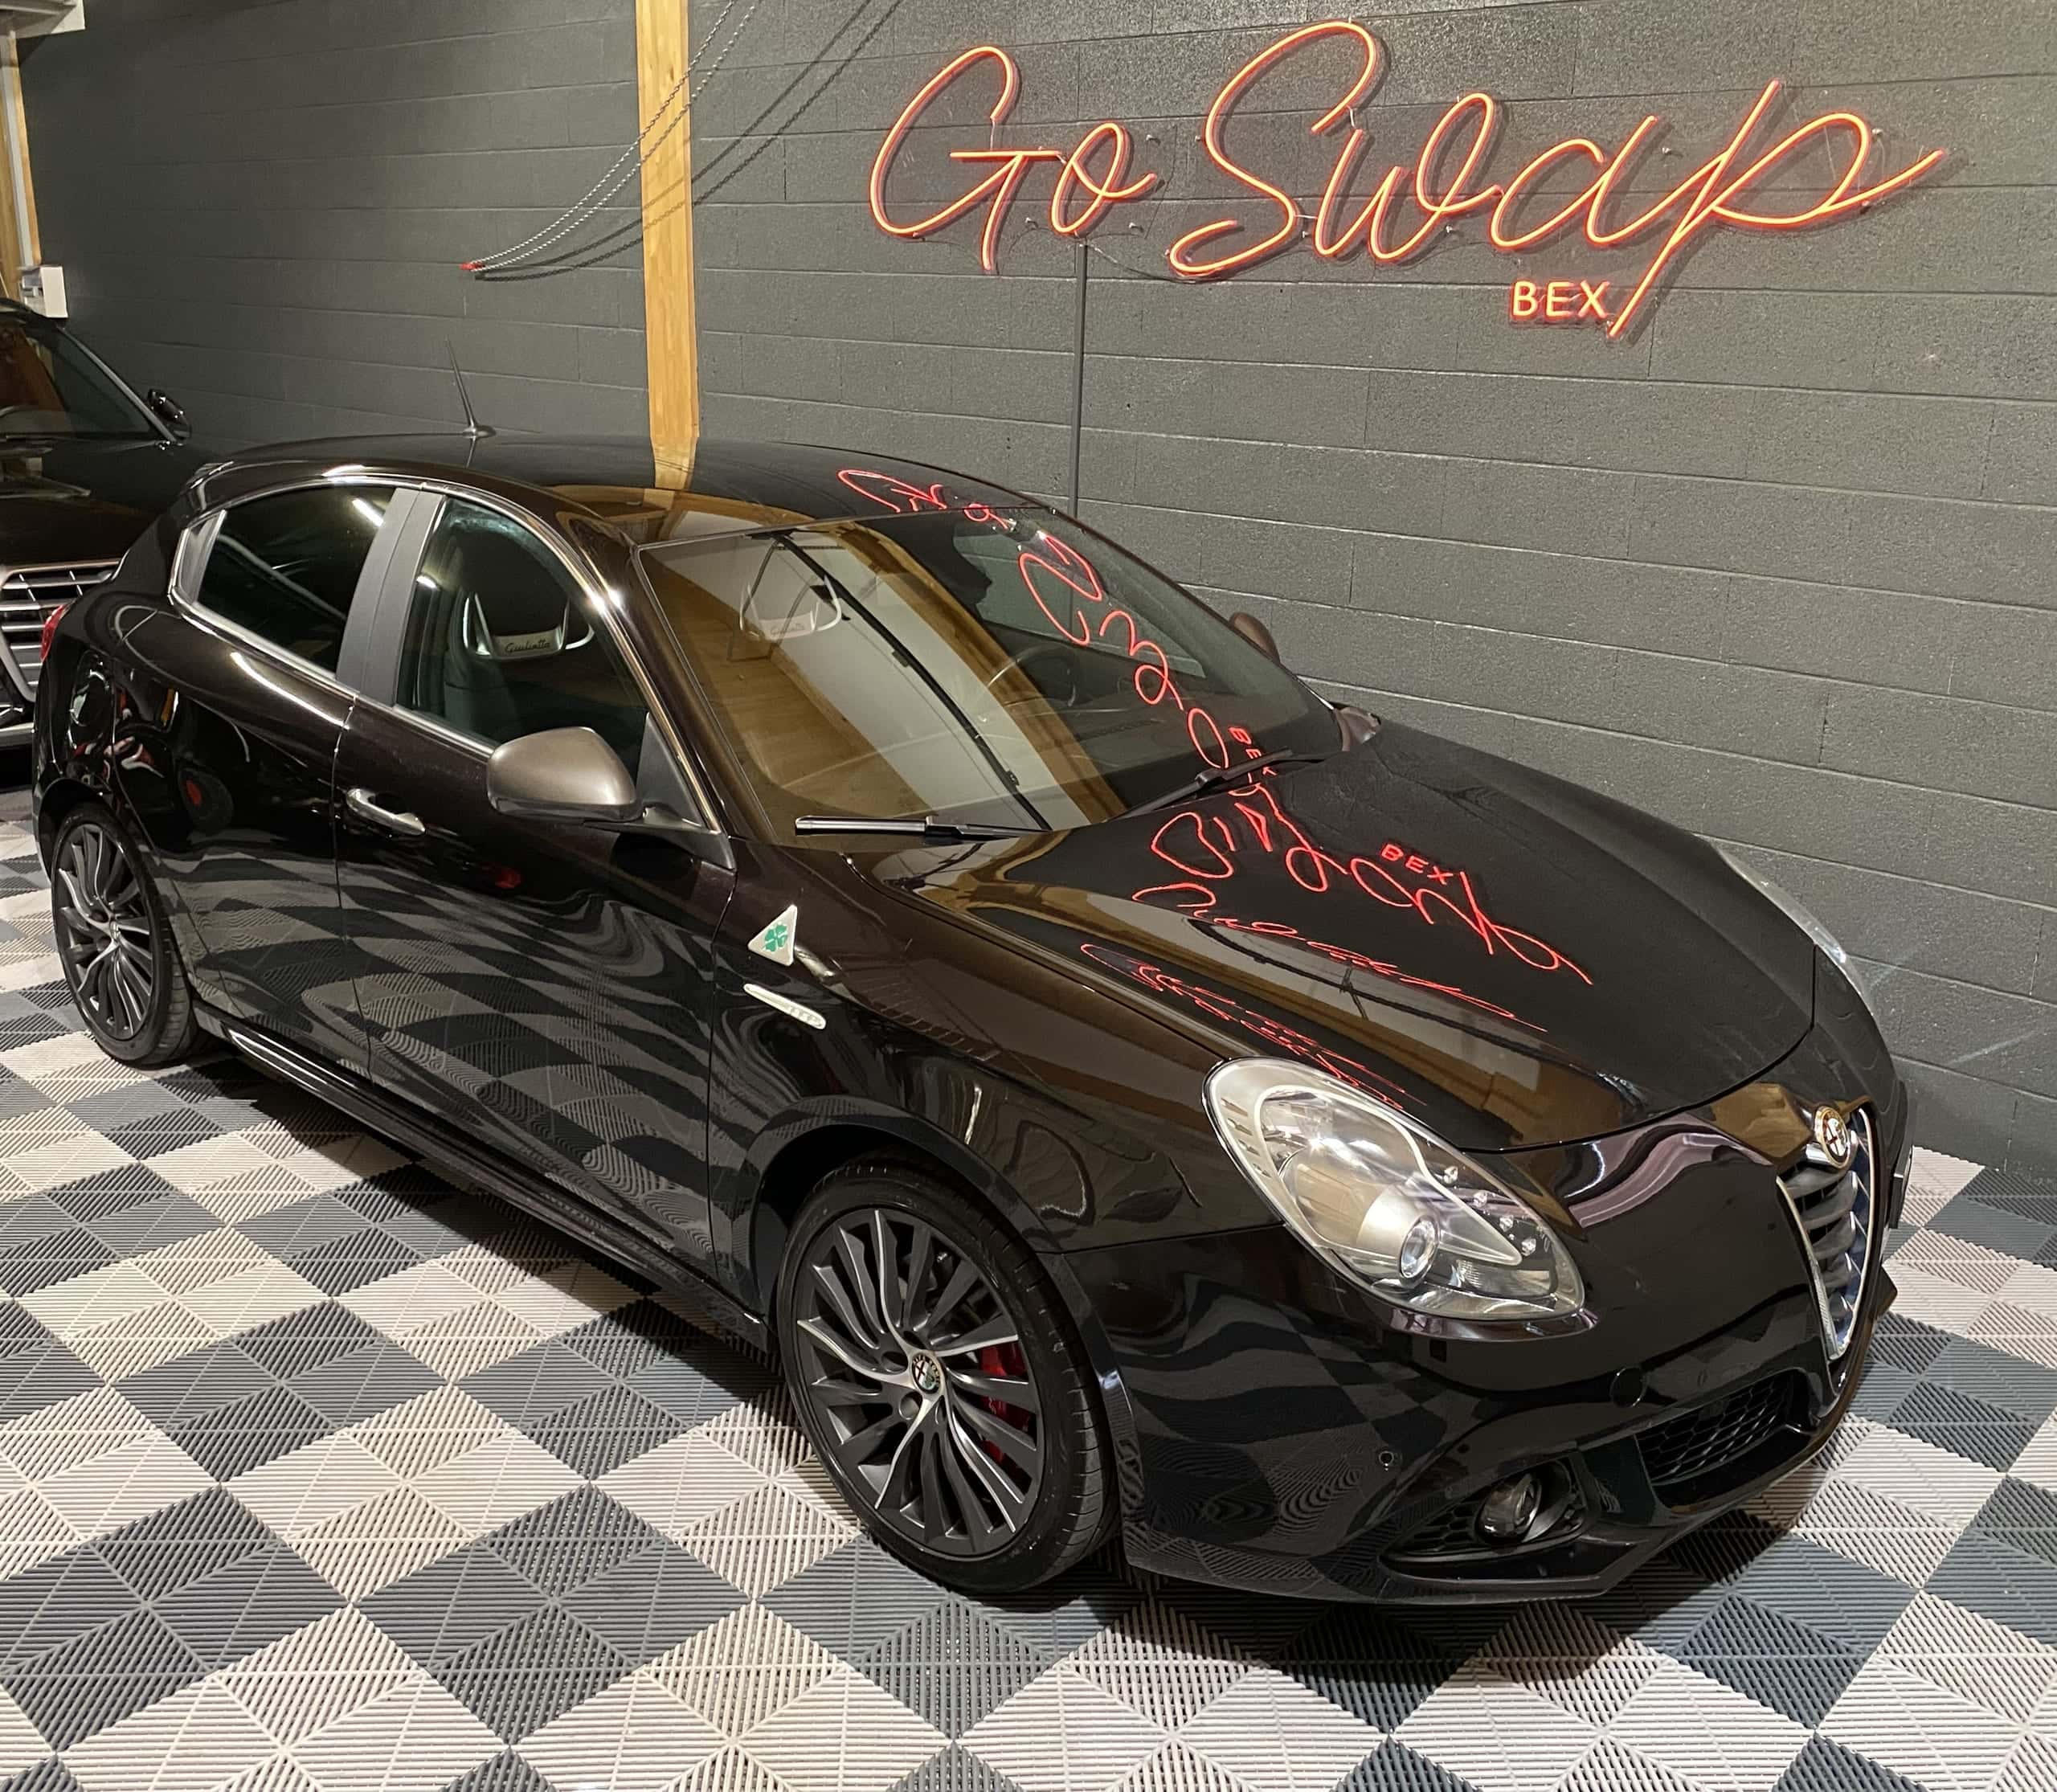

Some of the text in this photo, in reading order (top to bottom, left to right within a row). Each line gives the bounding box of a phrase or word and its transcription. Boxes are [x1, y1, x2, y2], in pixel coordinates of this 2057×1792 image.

[869, 19, 1945, 338] Go Swap
[1511, 280, 1610, 319] BEX
